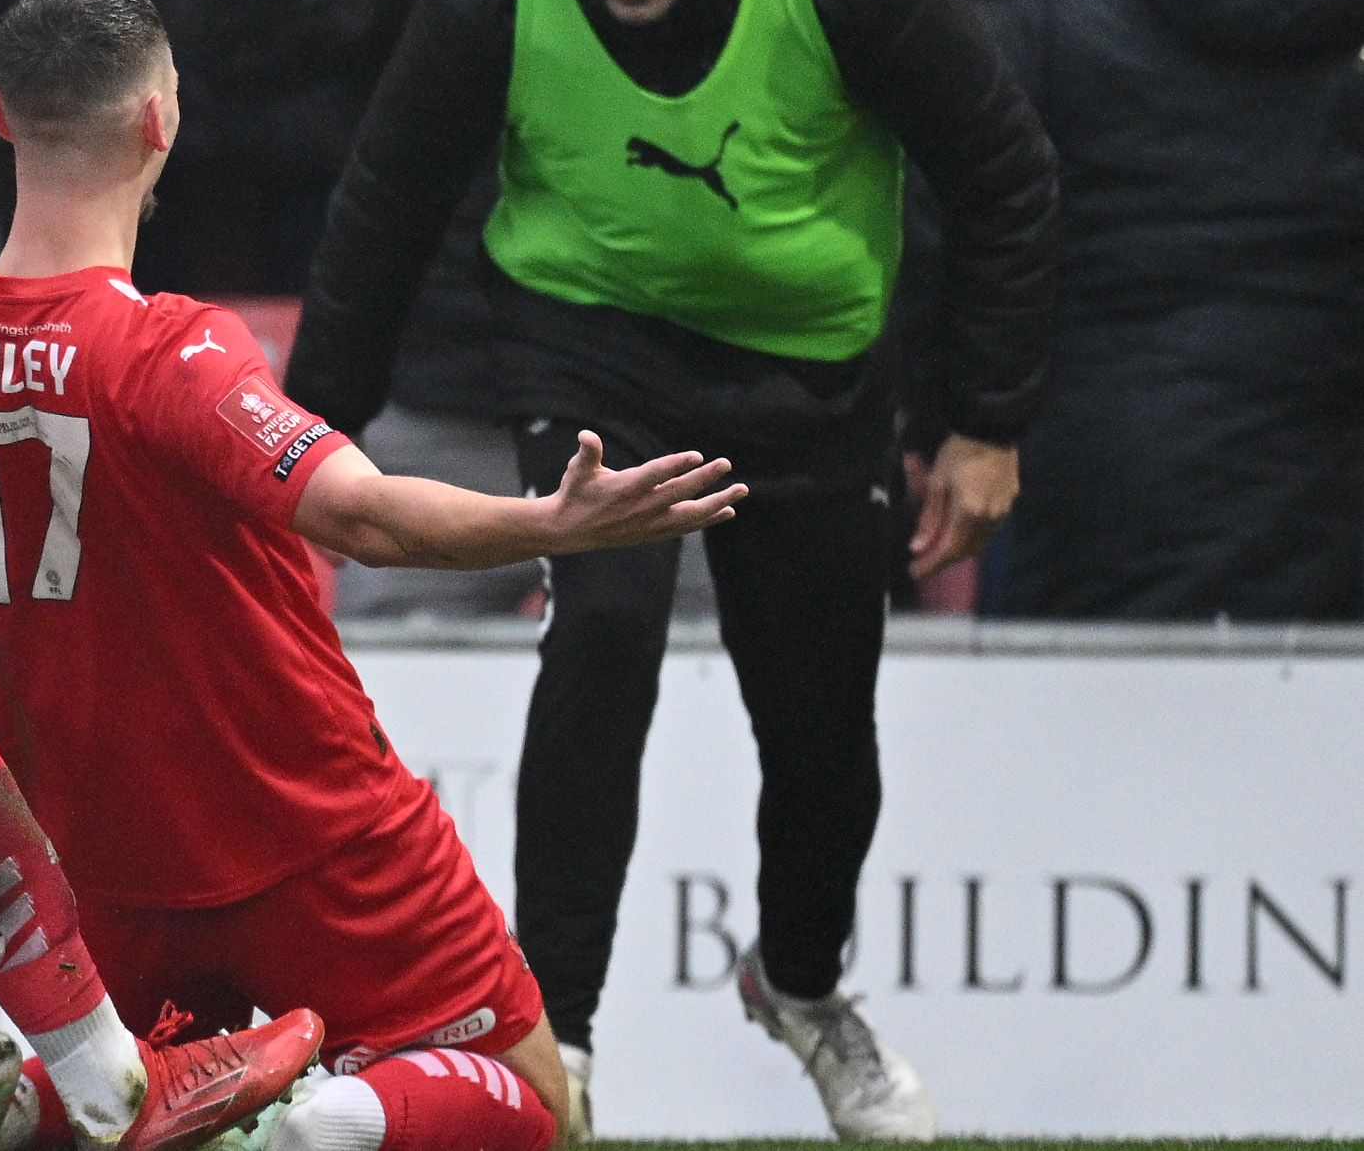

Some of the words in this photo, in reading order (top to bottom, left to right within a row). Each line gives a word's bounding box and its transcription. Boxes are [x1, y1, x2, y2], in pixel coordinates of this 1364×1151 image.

[264, 432, 283, 448] FA
[278, 414, 301, 434] CUP
[673, 873, 1351, 994] BILDIN
